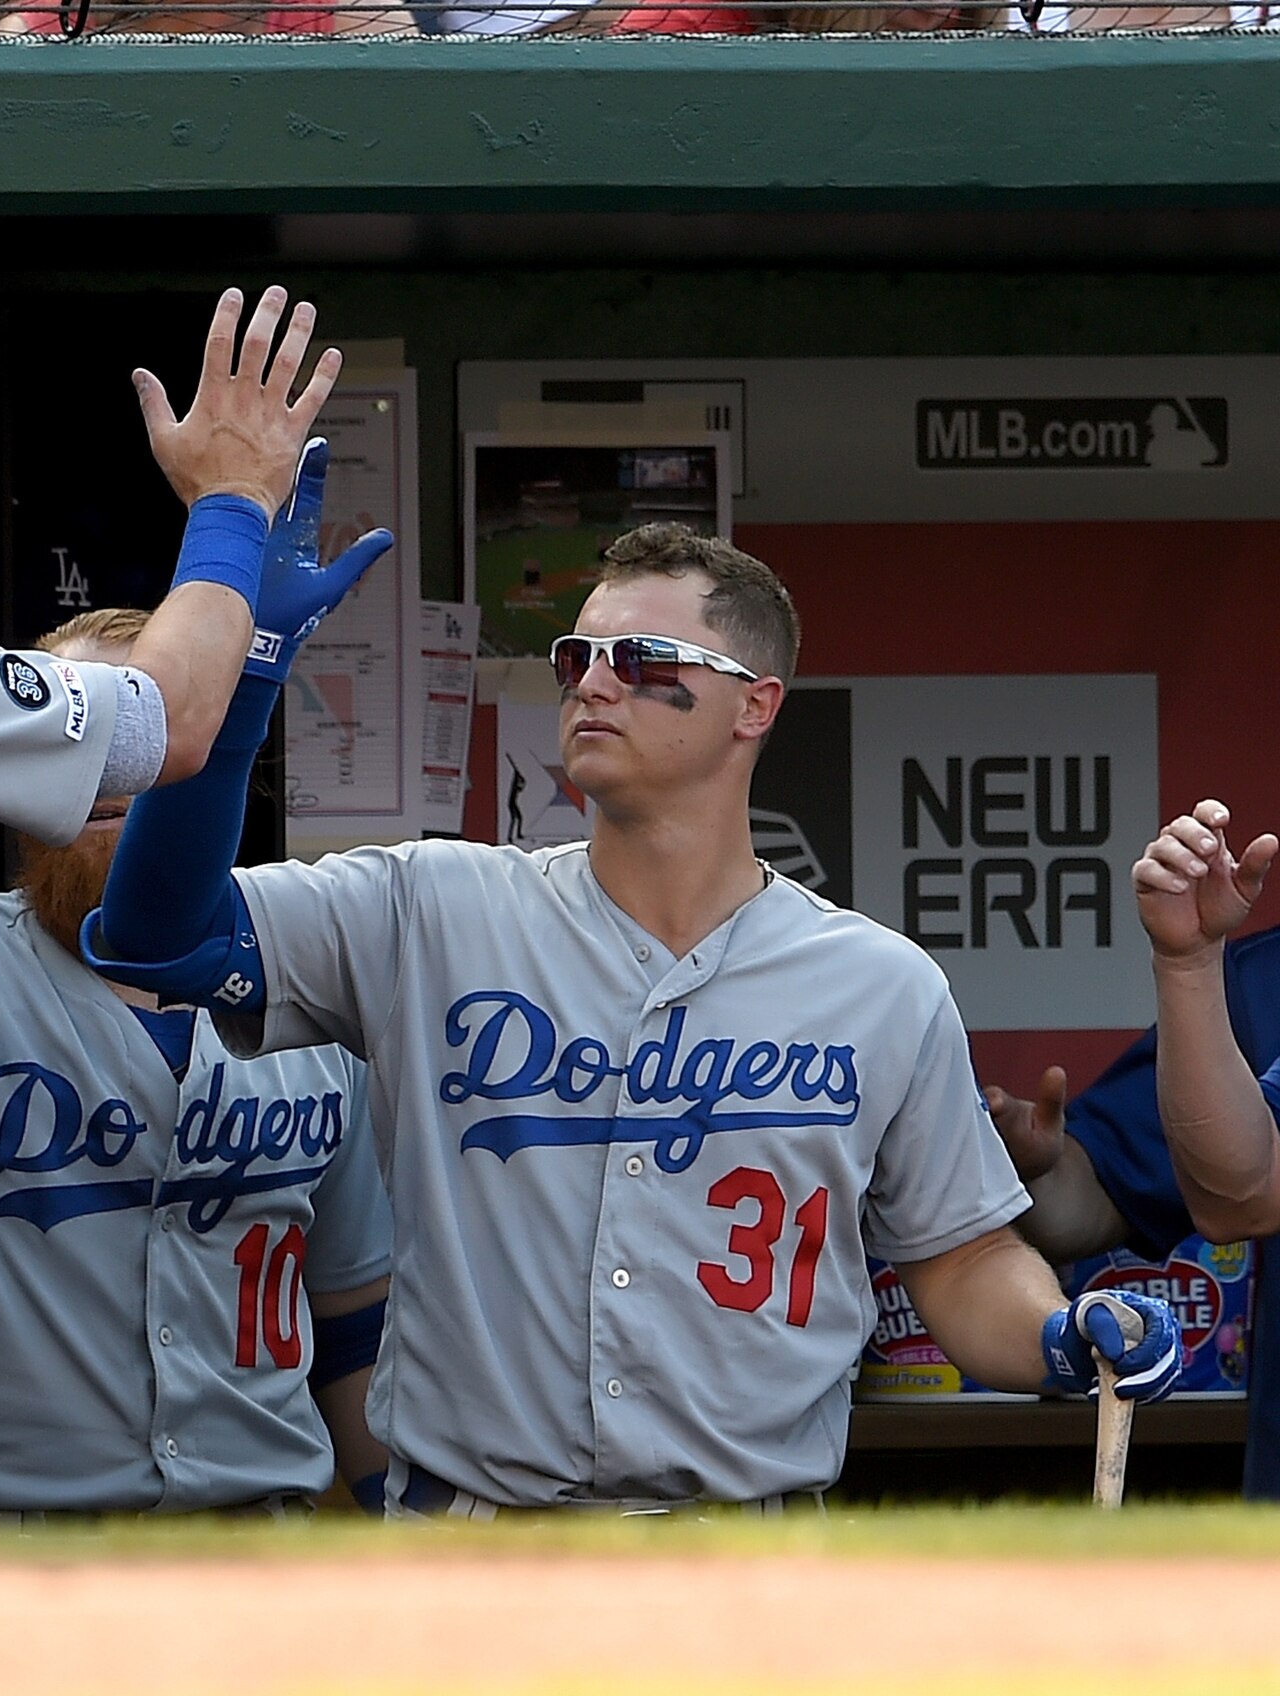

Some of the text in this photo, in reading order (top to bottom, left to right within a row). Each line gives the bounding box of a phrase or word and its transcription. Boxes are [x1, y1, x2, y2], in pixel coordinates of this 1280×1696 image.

[926, 409, 1138, 459] MLB.com
[51, 547, 92, 607] LA
[253, 633, 280, 658] 31
[13, 662, 43, 702] 36
[70, 692, 85, 735] MLB
[902, 757, 1111, 849] NEW
[904, 858, 1112, 949] ERA
[212, 972, 254, 1006] 31
[439, 990, 862, 1174] Dodgers
[696, 1166, 829, 1329] 31
[234, 1223, 307, 1370] 10
